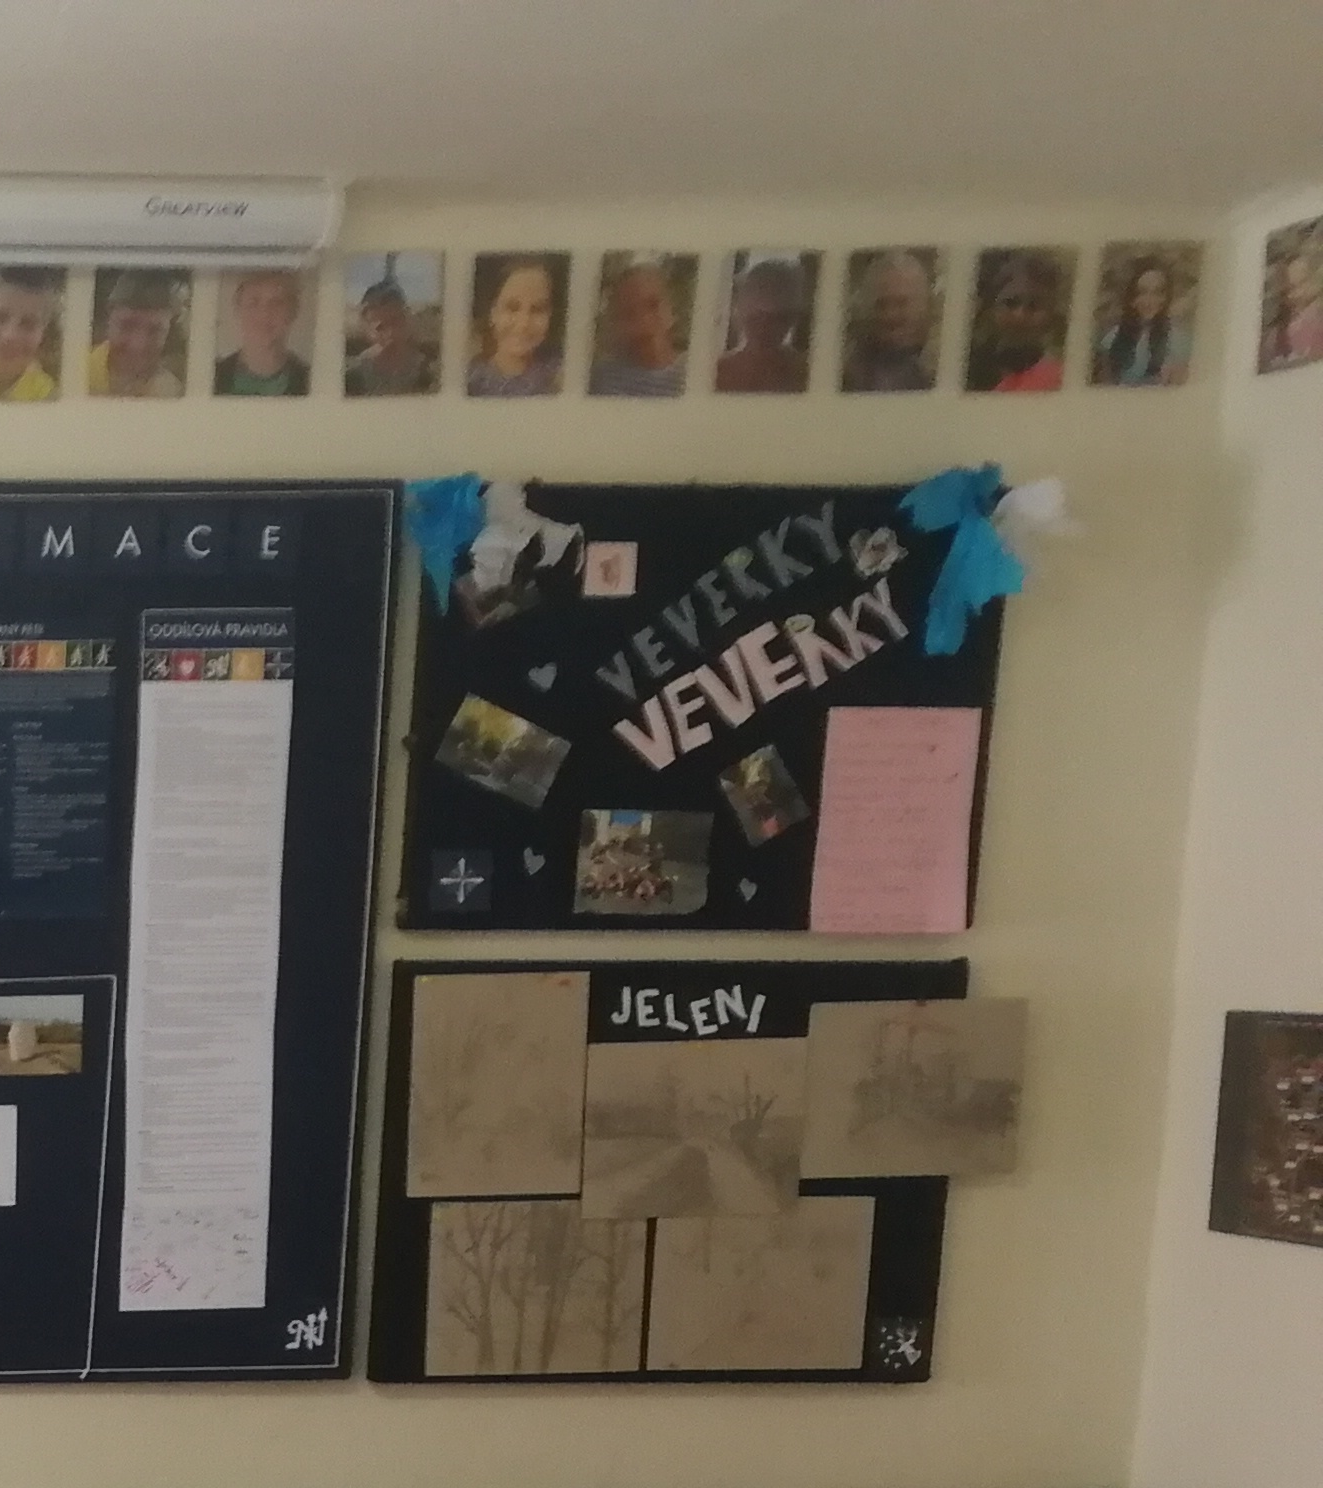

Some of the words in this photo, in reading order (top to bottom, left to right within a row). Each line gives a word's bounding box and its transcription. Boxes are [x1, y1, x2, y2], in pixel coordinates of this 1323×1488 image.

[595, 501, 845, 700] VEVERKY
[612, 576, 909, 772] VEVERKY
[610, 984, 766, 1036] JELENI
